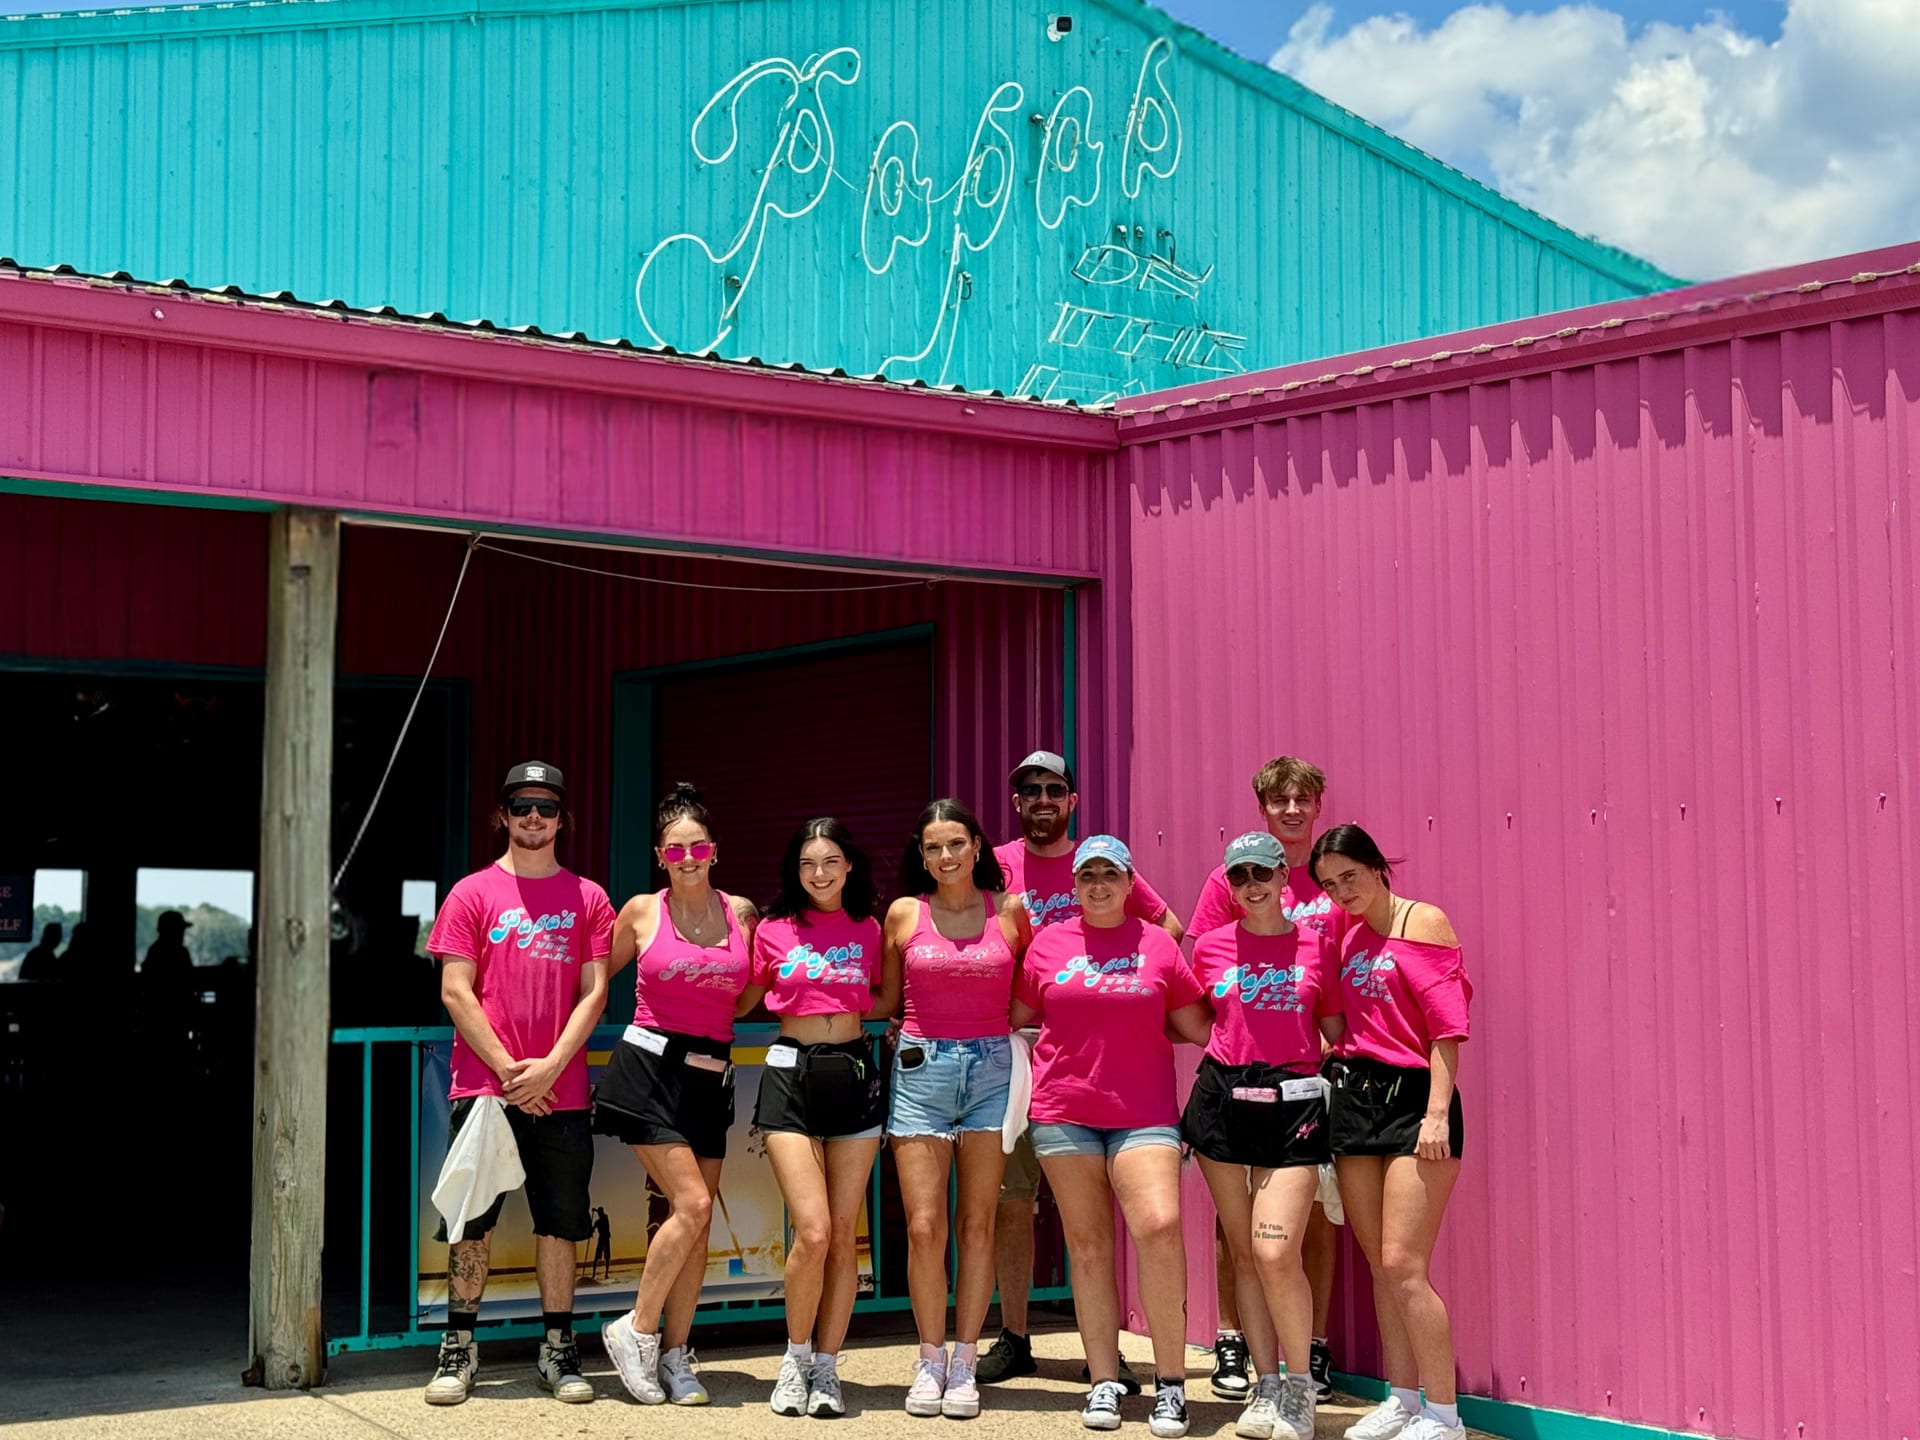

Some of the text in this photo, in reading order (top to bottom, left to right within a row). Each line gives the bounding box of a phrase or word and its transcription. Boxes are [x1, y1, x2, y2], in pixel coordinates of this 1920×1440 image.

[489, 907, 577, 949] Papa's
[779, 942, 864, 980] Papa's
[1055, 952, 1146, 987] Papa's
[1213, 963, 1306, 1004] Papa's
